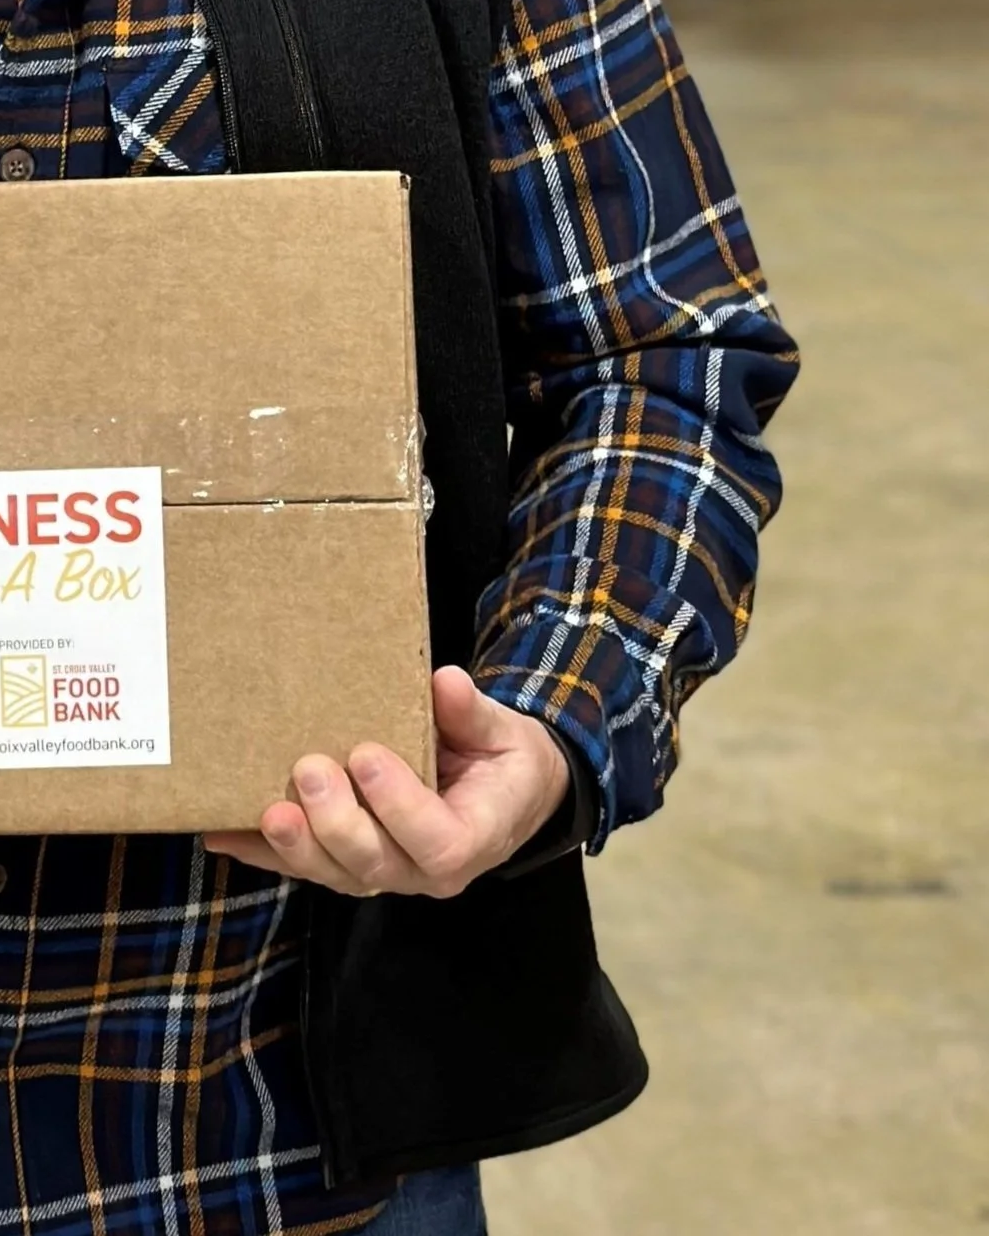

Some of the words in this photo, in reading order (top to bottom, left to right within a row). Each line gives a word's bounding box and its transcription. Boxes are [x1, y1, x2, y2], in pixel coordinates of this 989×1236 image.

[0, 550, 37, 604] A
[54, 547, 143, 603] Box
[57, 638, 75, 650] BY:
[52, 664, 63, 675] ST.
[64, 664, 87, 674] CROIX
[88, 663, 116, 674] VALLEY
[53, 677, 120, 699] FOOD
[53, 701, 121, 722] BANK
